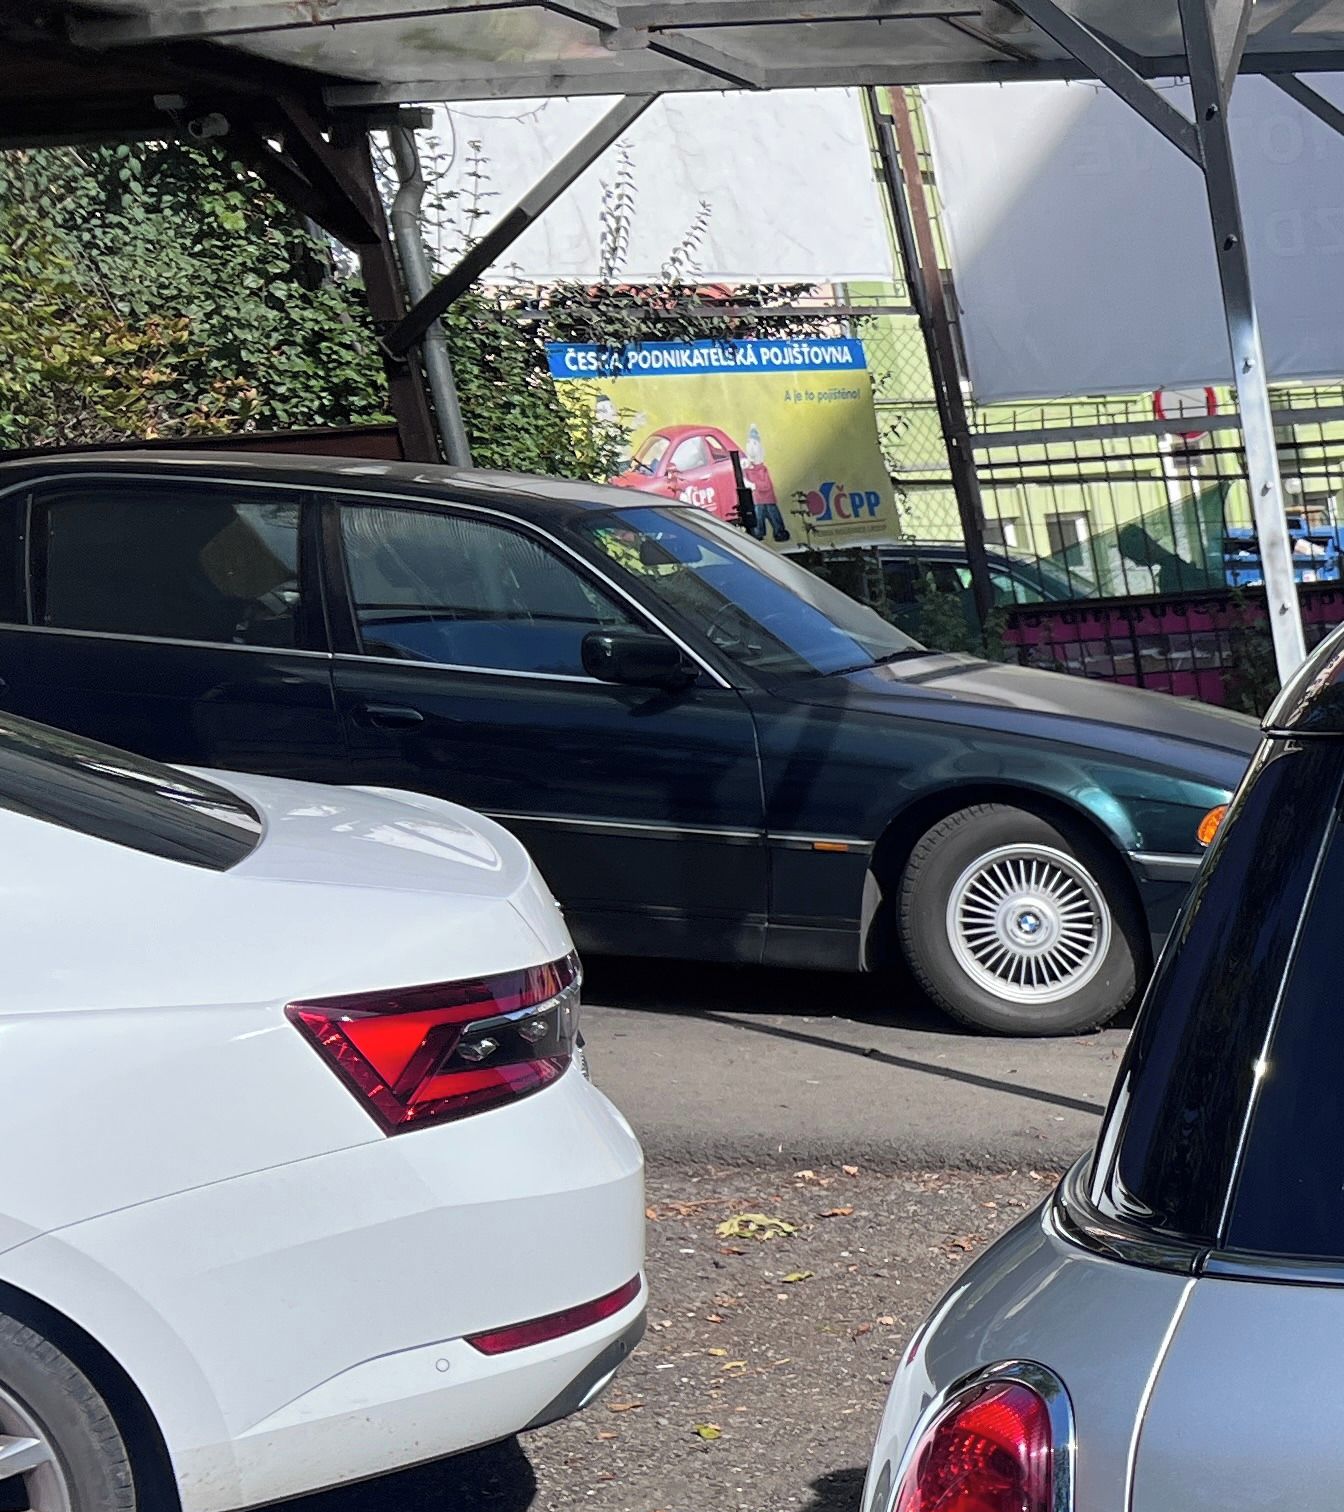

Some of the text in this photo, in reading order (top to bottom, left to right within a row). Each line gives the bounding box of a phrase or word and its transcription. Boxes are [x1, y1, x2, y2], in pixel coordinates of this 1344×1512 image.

[760, 343, 853, 366] POJIŠŤOVNA
[784, 390, 792, 402] A
[793, 390, 802, 402] je
[804, 389, 815, 401] to
[833, 483, 882, 519] ČPP
